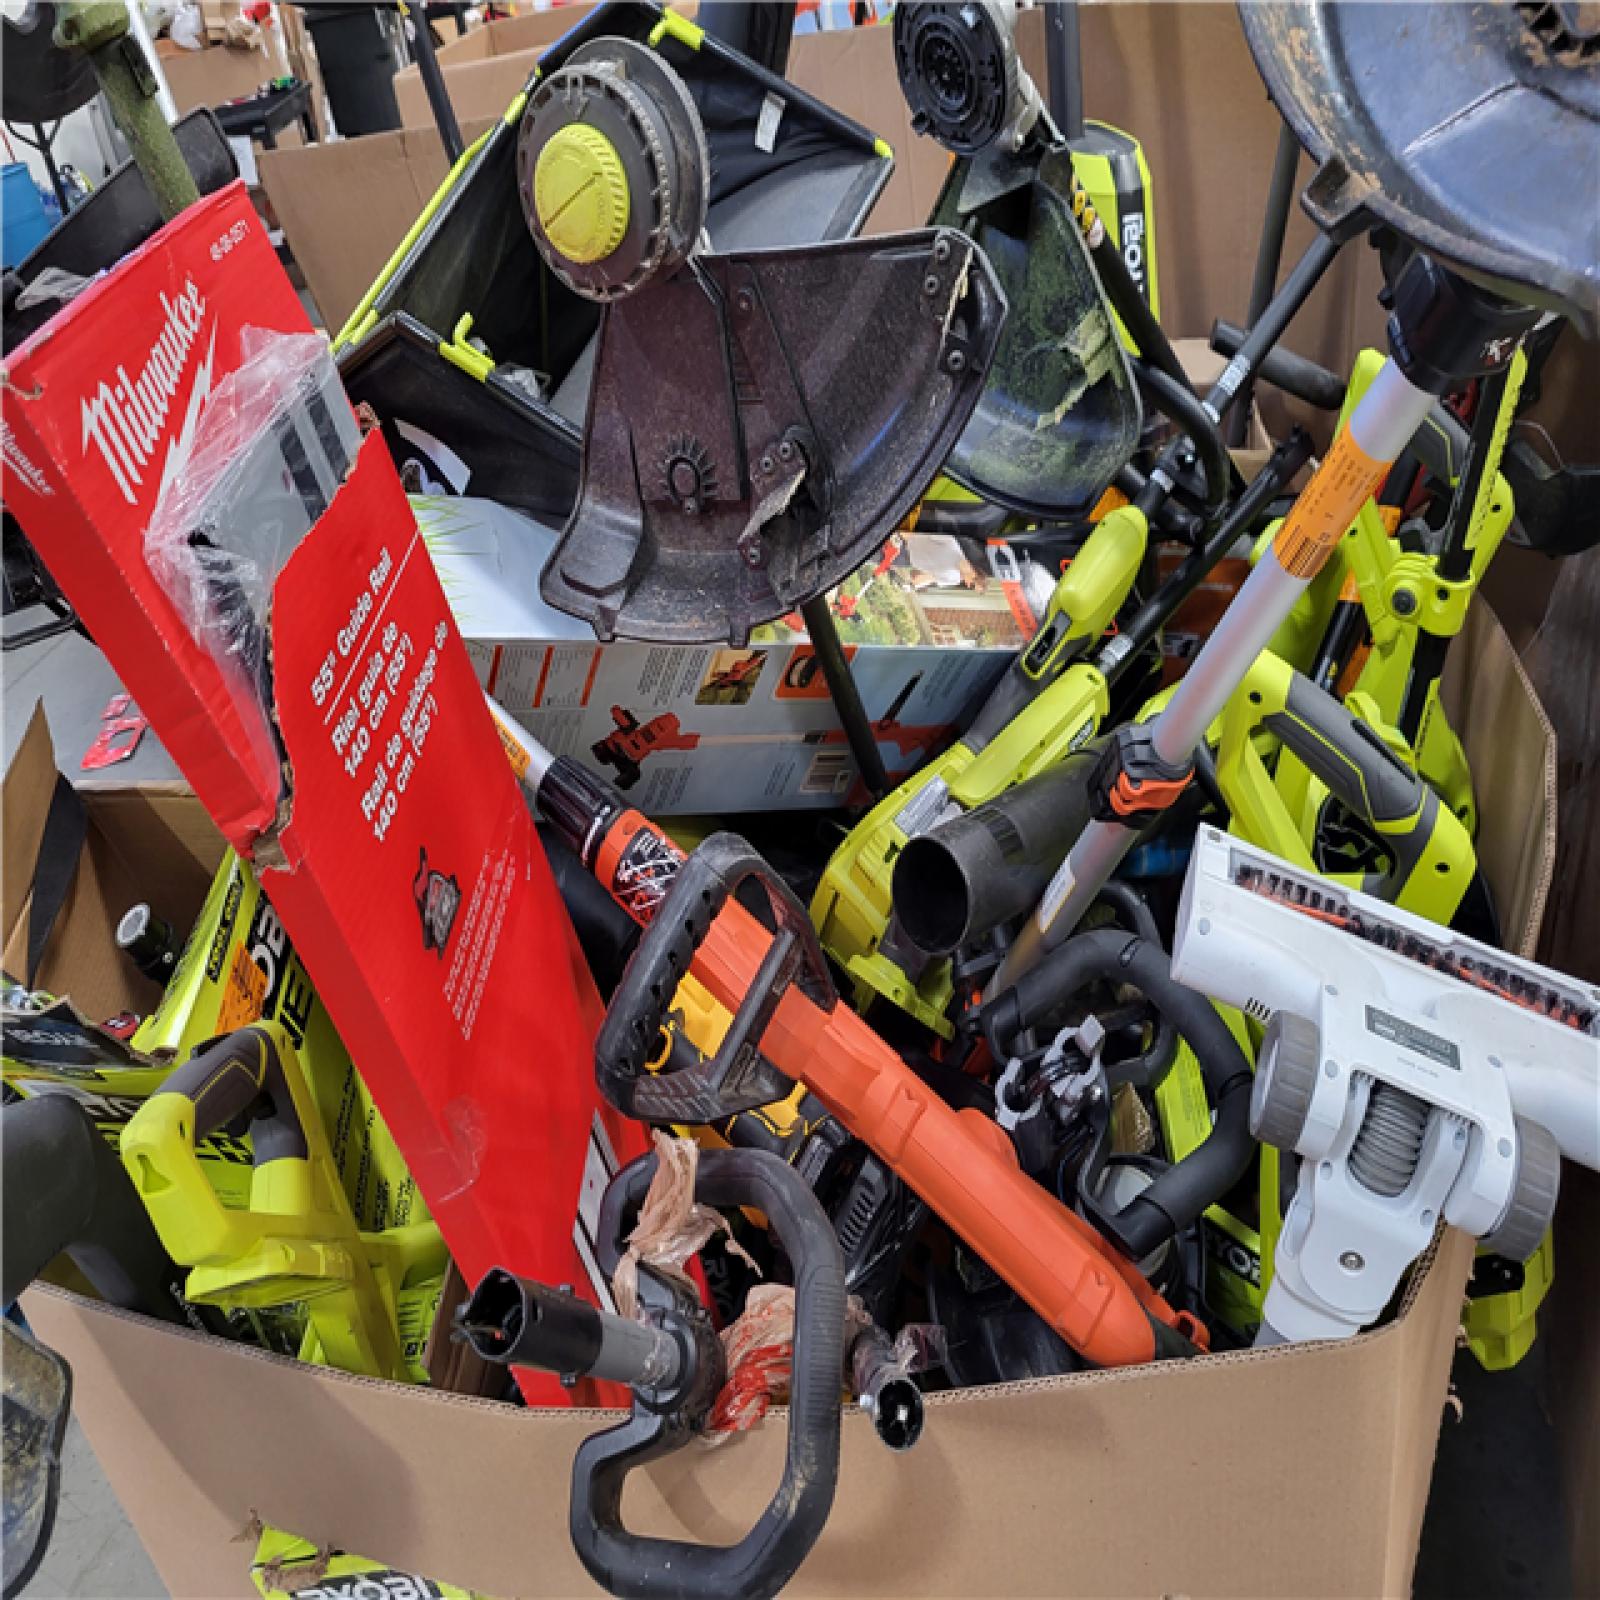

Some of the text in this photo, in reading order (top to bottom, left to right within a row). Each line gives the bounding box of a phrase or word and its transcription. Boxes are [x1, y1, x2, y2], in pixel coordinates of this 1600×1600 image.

[80, 279, 206, 505] Milwaukee
[311, 546, 393, 706] 55" Guide Rail
[331, 696, 361, 756] Riel
[382, 621, 398, 654] de
[344, 726, 371, 778] 140
[369, 689, 389, 731] cm
[360, 761, 389, 821] Rail
[386, 733, 402, 769] de
[434, 619, 449, 651] de
[373, 789, 398, 842] 140
[396, 752, 416, 793] cm
